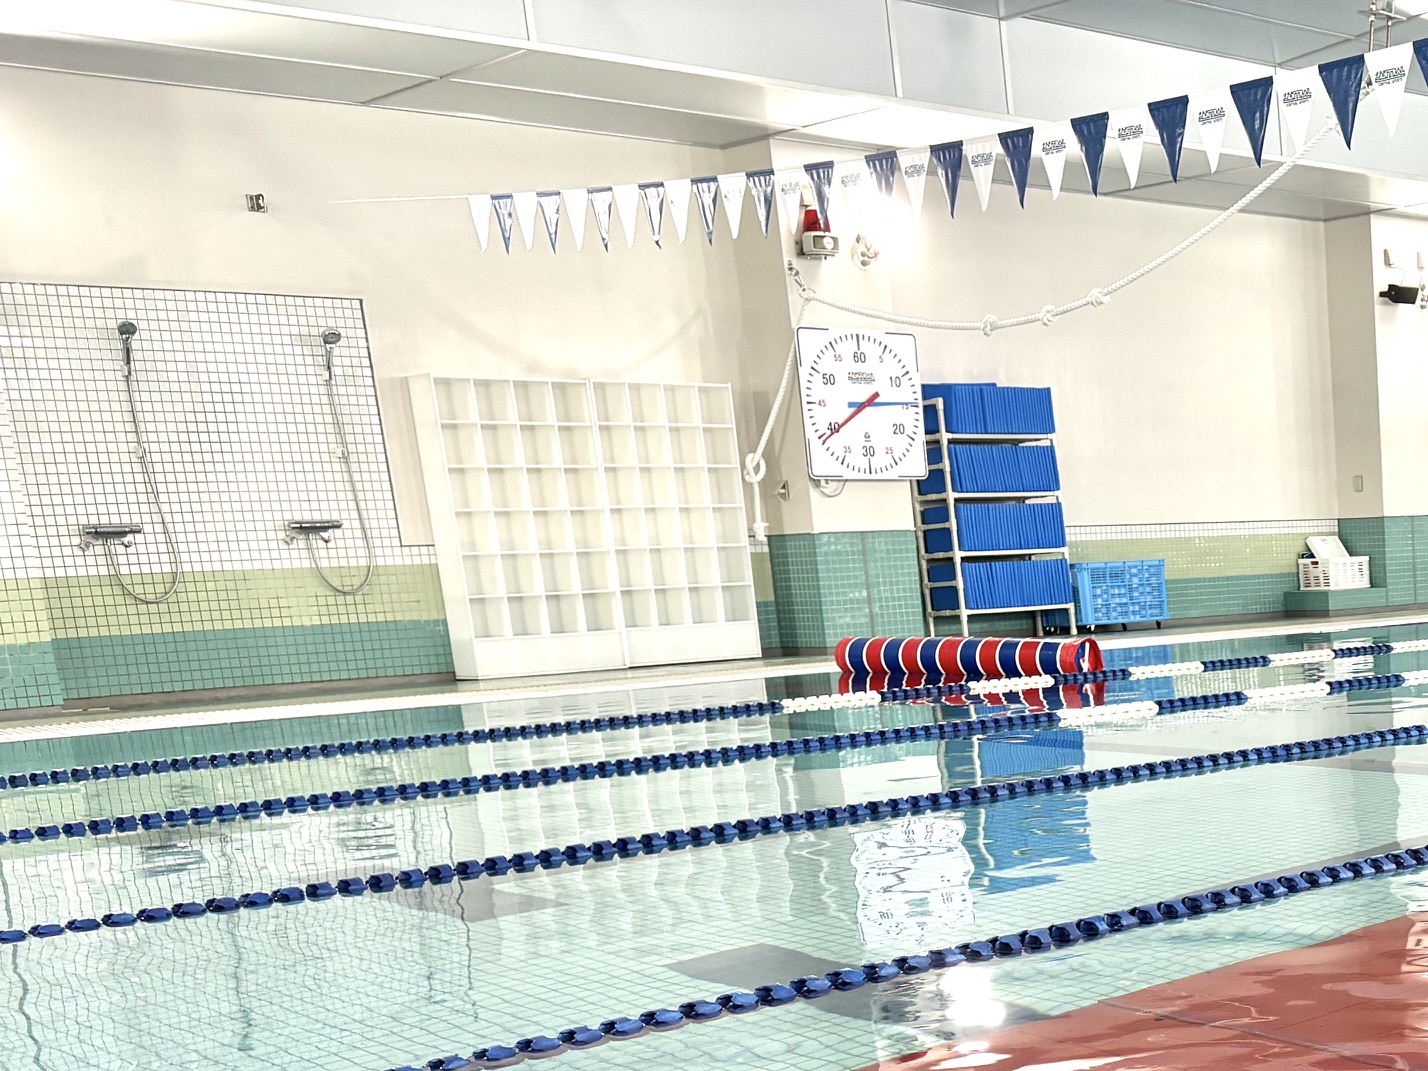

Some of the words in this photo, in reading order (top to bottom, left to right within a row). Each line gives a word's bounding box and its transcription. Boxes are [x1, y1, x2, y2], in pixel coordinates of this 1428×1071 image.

[834, 354, 843, 362] 55
[853, 352, 866, 364] 60
[879, 355, 884, 363] 5
[822, 373, 836, 385] 50
[889, 376, 902, 388] 10
[818, 399, 827, 407] 45
[827, 421, 840, 433] 40
[893, 423, 905, 435] 20
[843, 445, 852, 454] 35
[862, 445, 875, 457] 30
[885, 446, 894, 455] 25
